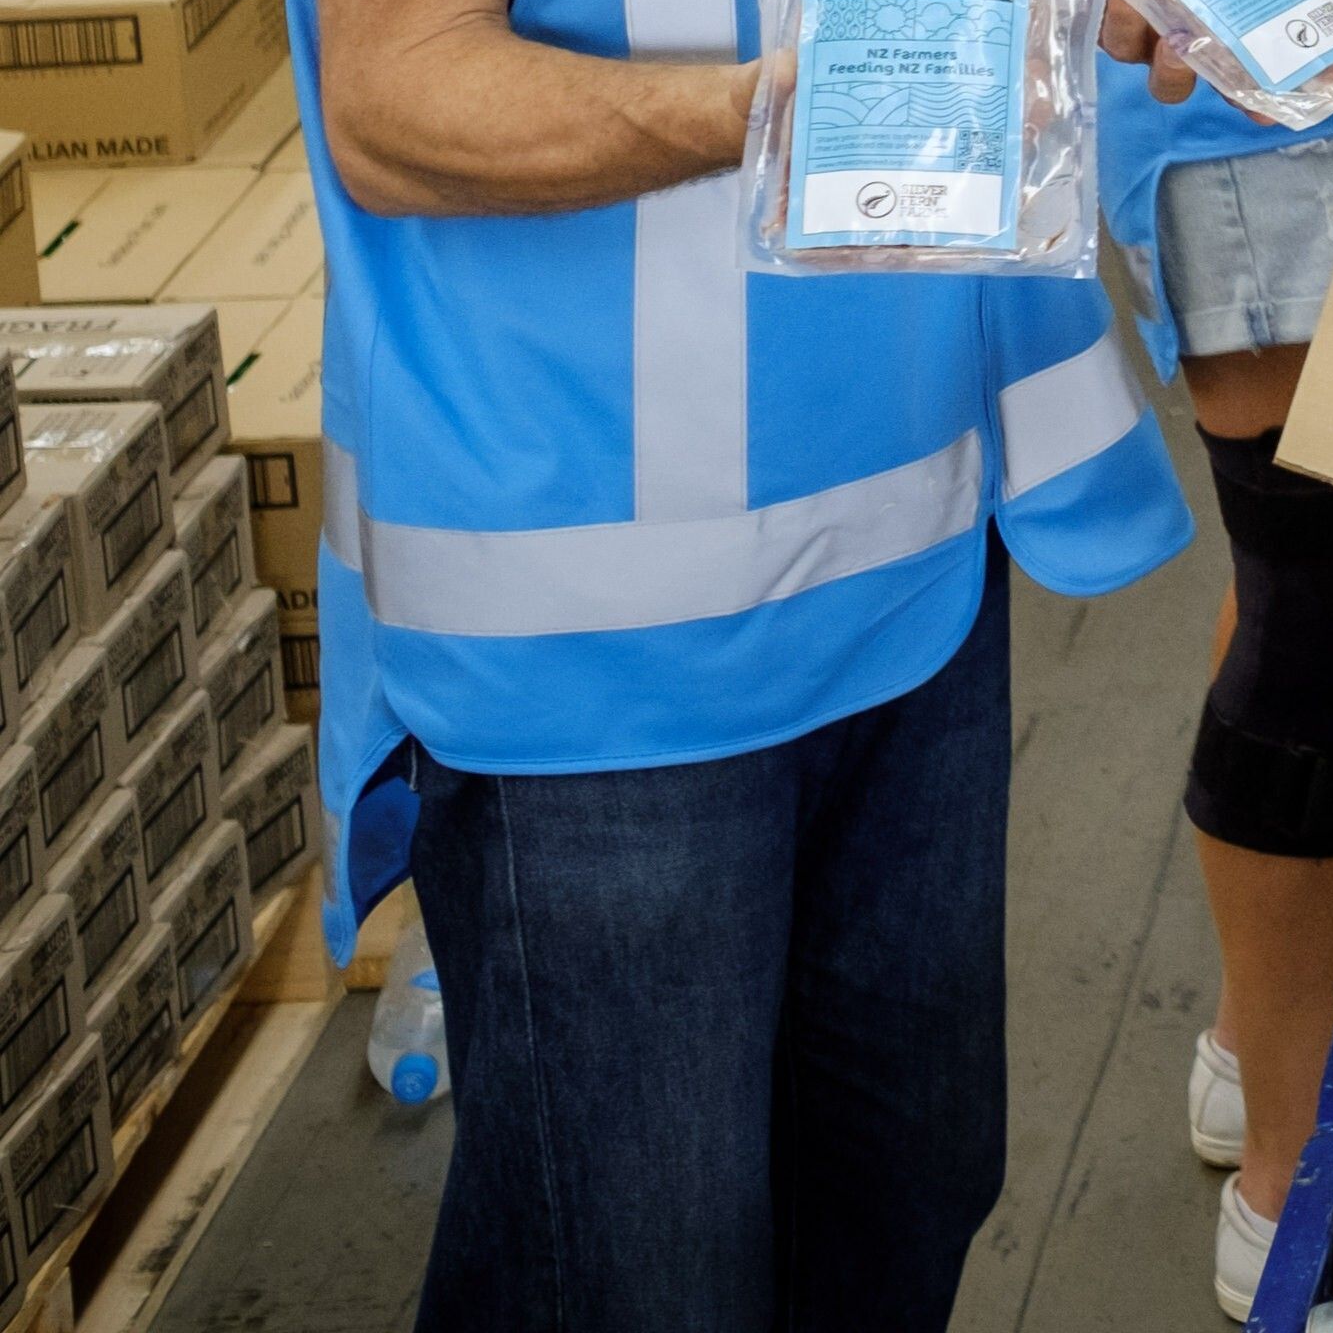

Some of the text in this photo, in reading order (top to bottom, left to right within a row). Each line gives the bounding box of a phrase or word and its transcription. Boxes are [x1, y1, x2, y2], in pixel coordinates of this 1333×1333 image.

[867, 49, 957, 60] NZ Farmers
[828, 64, 900, 76] Feeding
[901, 64, 920, 74] NZ
[28, 135, 168, 161] LIAN MADE
[0, 318, 118, 334] FRAG
